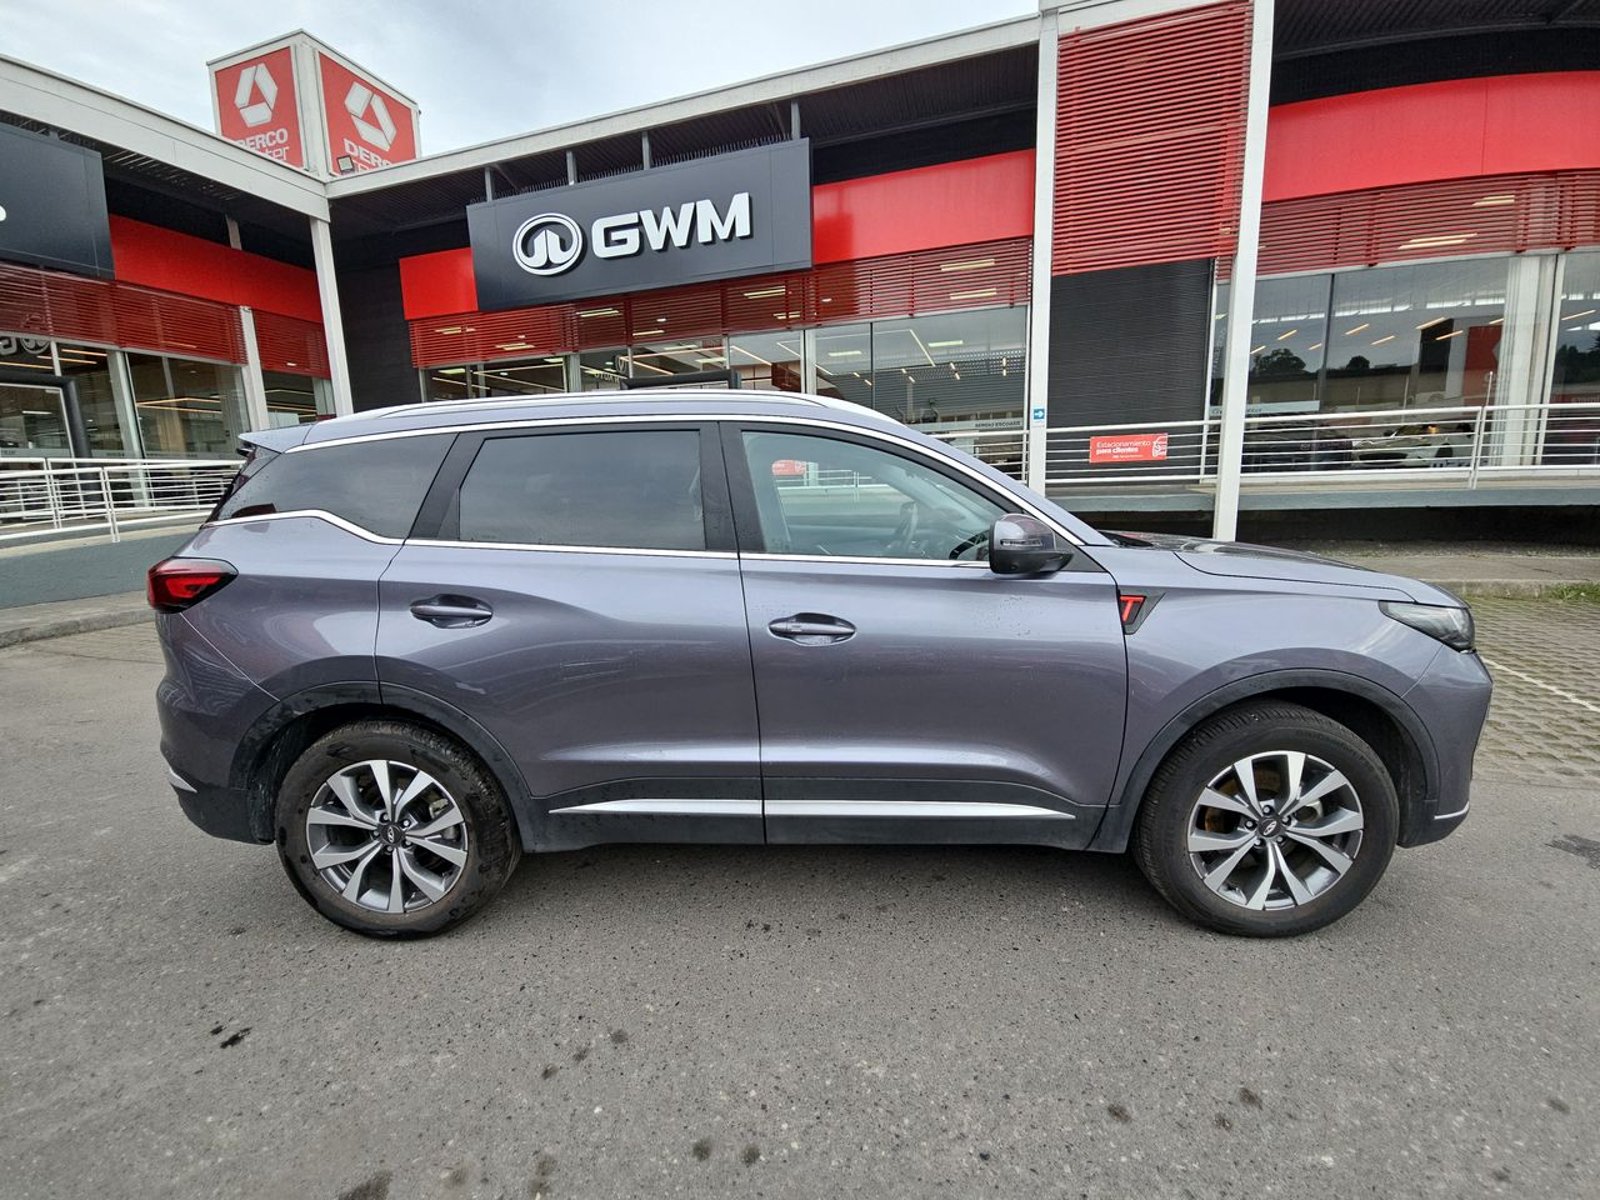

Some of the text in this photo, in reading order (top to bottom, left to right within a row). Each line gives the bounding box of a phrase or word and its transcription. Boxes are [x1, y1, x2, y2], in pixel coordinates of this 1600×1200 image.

[343, 137, 393, 168] DER
[591, 192, 751, 258] GWM
[1095, 446, 1139, 455] para clientes
[1096, 440, 1151, 448] Estacionamiento
